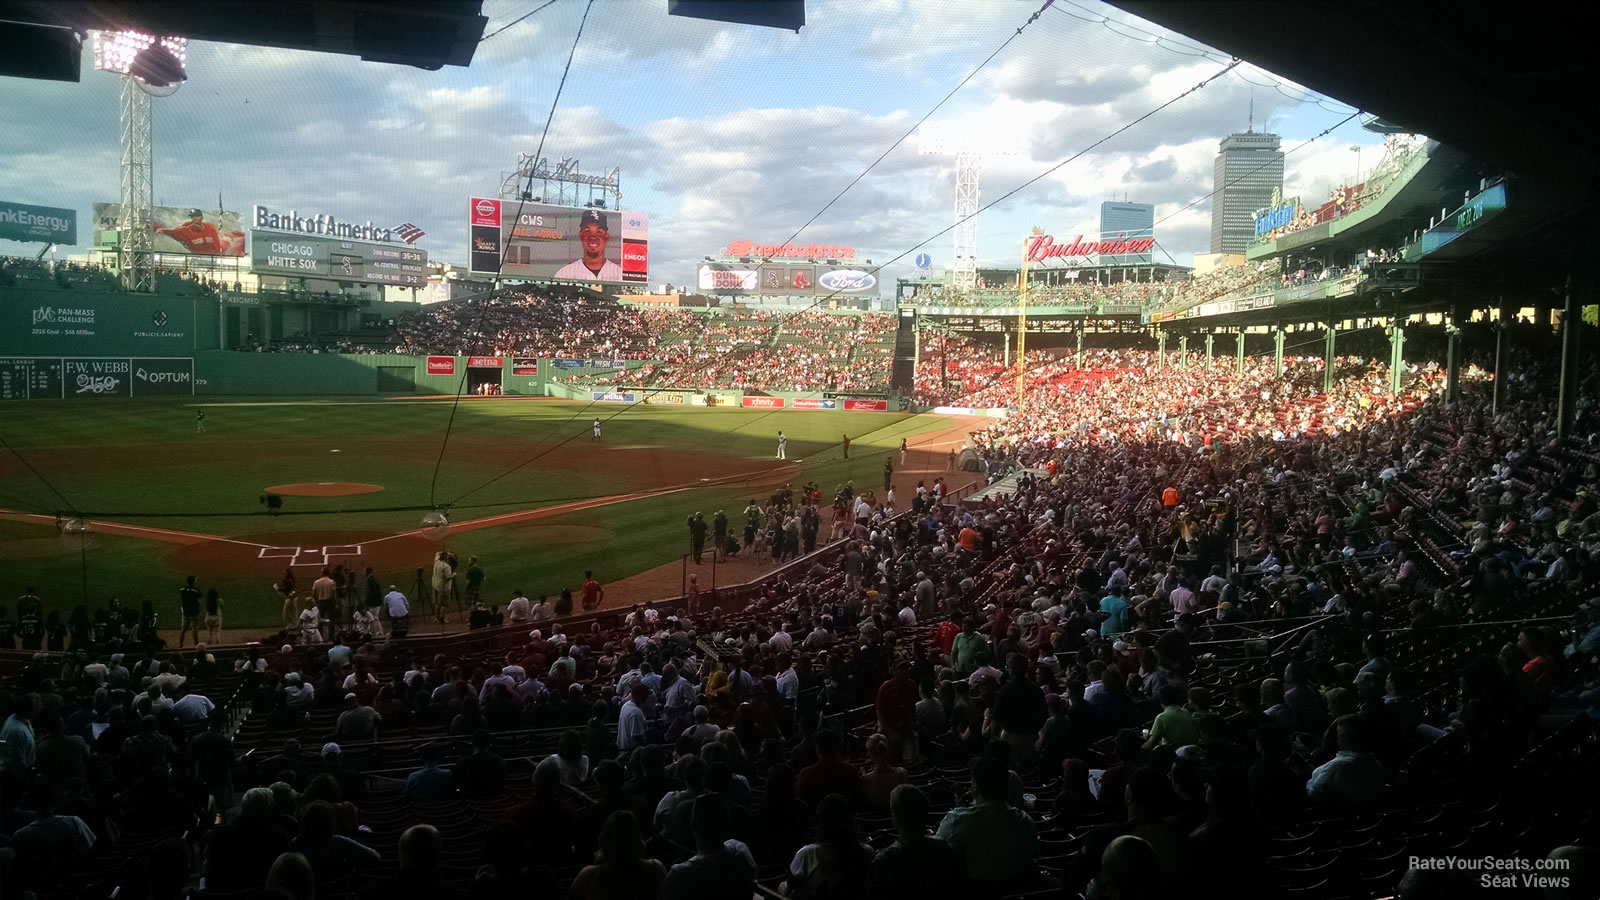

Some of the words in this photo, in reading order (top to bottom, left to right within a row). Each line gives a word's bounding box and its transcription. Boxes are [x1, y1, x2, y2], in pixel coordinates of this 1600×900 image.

[254, 204, 303, 232] Bank
[303, 213, 323, 234] of
[325, 215, 391, 243] America
[521, 214, 543, 226] CWS
[271, 242, 313, 257] CHICAGO
[1028, 233, 1155, 261] Budweiser
[267, 256, 296, 269] WHITE
[299, 258, 317, 270] SOX
[831, 272, 865, 289] Ford
[58, 308, 95, 317] PAN-MASS
[58, 316, 95, 324] CHALLENGE
[66, 362, 89, 374] F.W.
[92, 361, 129, 374] WEBB
[472, 357, 498, 366] aetna
[149, 372, 190, 383] OPTUM
[751, 398, 775, 407] xfinity
